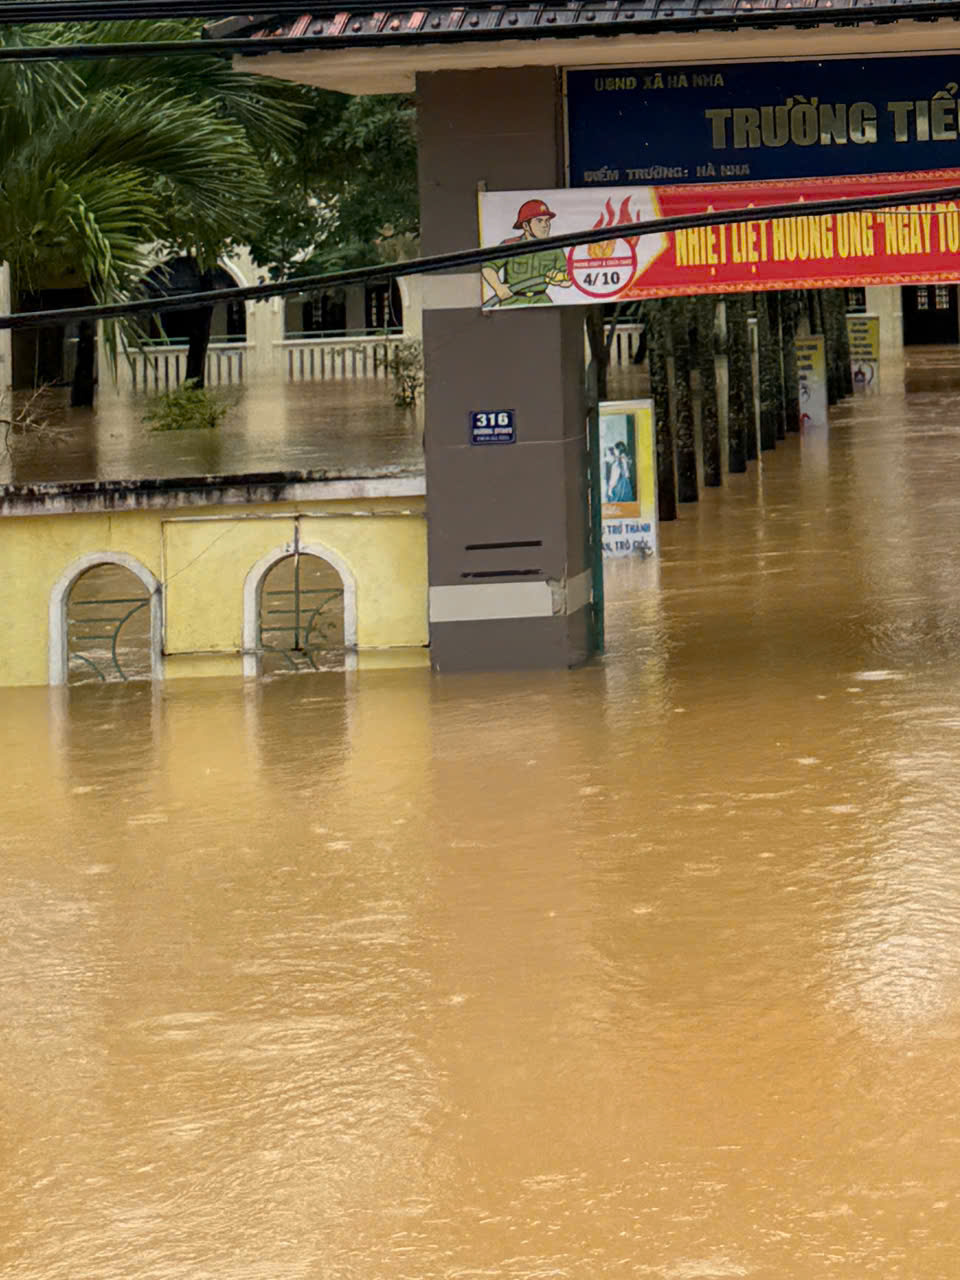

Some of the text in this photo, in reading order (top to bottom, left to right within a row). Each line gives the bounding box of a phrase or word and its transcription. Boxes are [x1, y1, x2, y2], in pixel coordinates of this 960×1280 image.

[595, 77, 637, 91] UBND
[643, 73, 664, 89] XÃ
[693, 73, 724, 87] NHA
[705, 95, 877, 150] TRƯỜNG
[696, 163, 716, 177] HÀ
[583, 270, 620, 286] 4/10
[476, 412, 509, 427] 316
